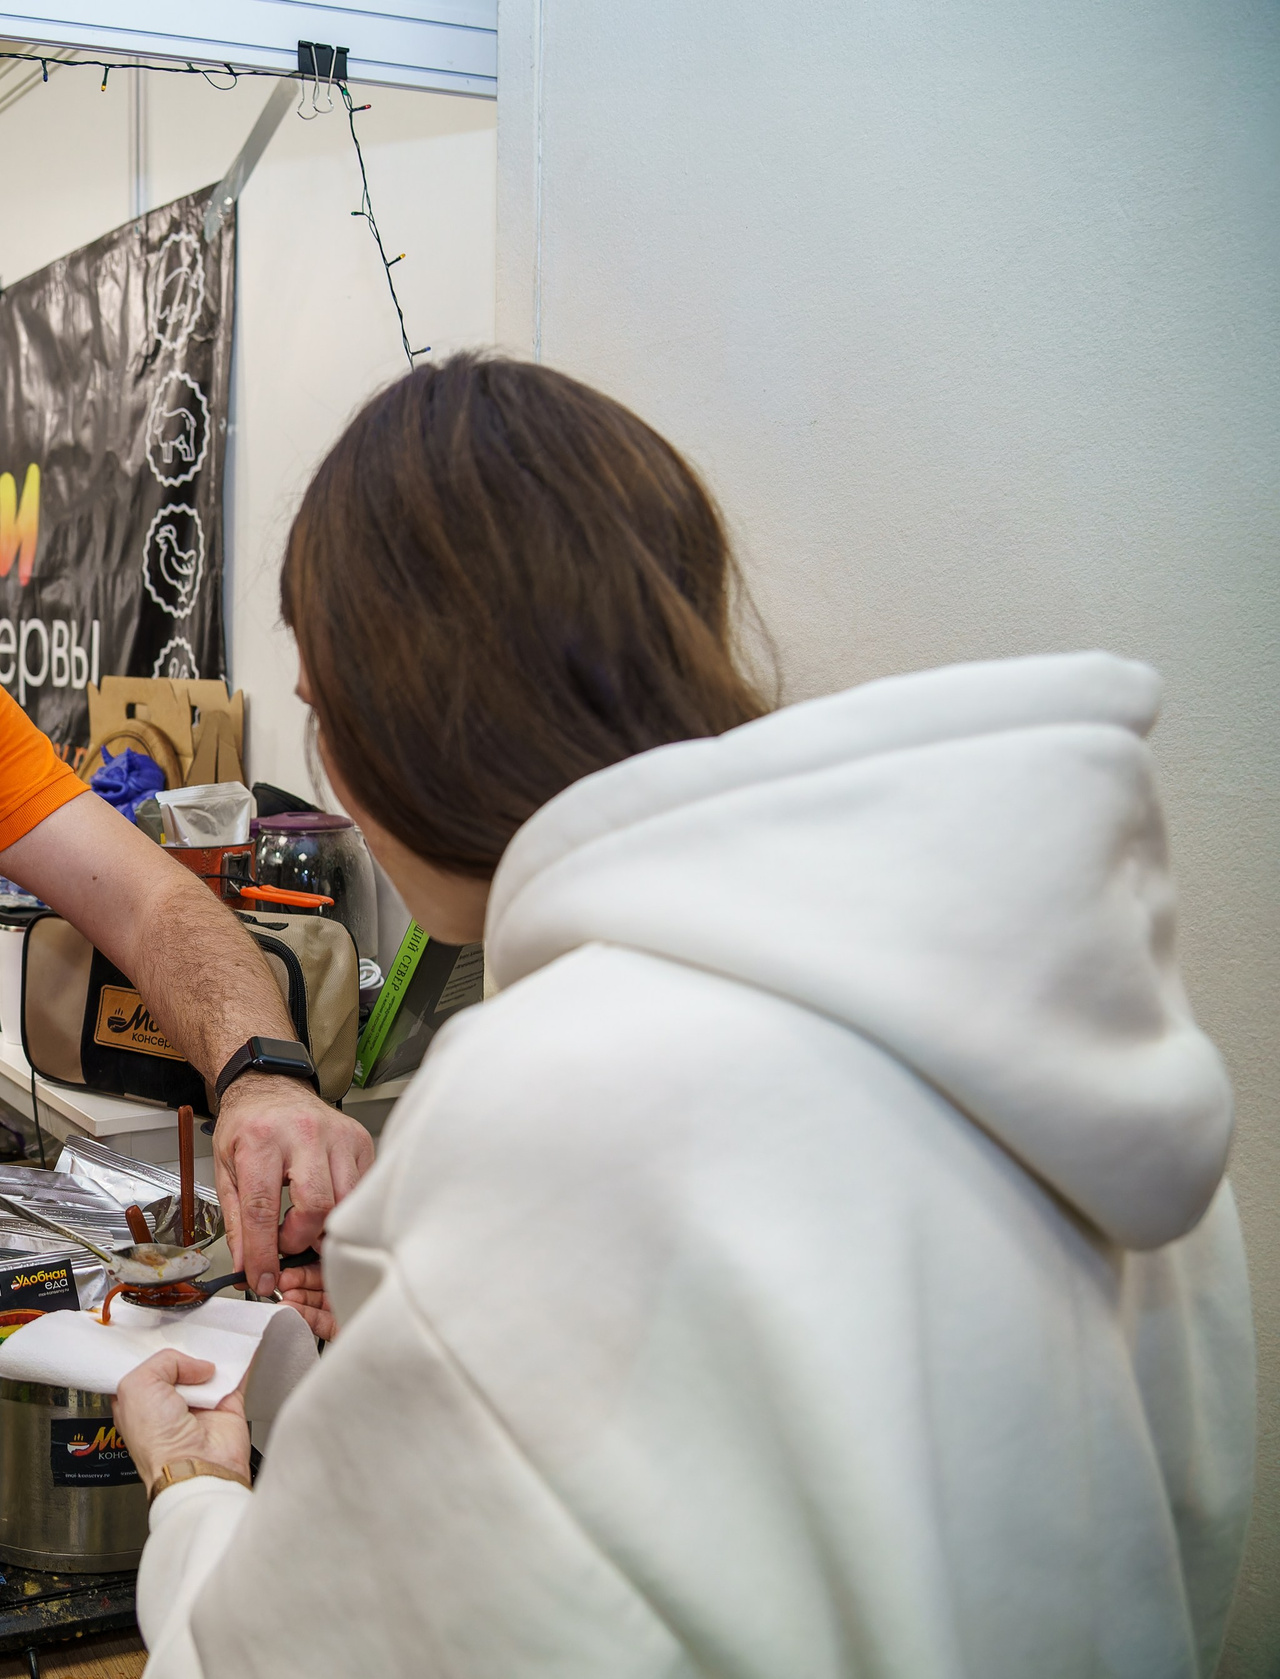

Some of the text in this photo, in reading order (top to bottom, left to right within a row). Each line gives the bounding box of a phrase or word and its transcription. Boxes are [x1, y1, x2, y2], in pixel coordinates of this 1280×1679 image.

[391, 954, 413, 992] СЕВЕР
[132, 1032, 175, 1050] консер
[15, 1268, 67, 1287] Удобная
[44, 1278, 69, 1290] еда
